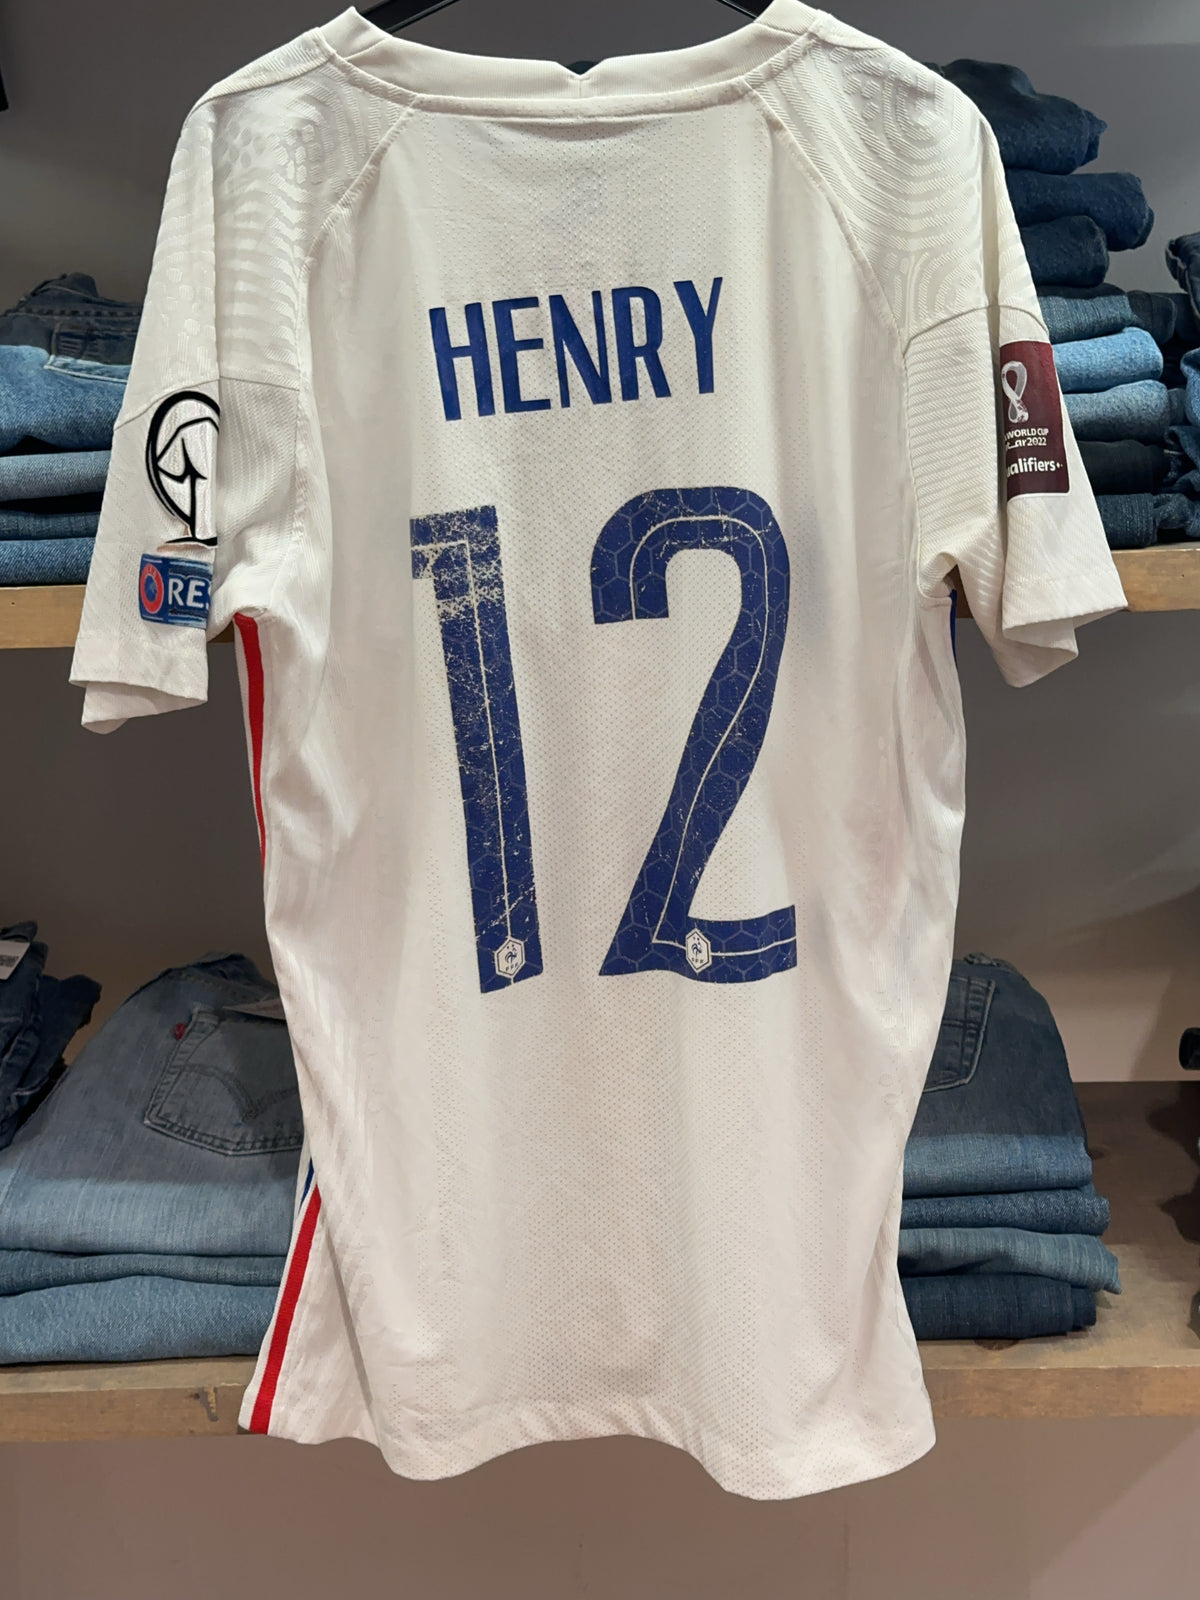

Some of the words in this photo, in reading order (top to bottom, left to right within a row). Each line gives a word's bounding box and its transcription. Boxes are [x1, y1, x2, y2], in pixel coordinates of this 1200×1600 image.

[428, 277, 723, 421] HENRY
[1007, 457, 1056, 477] alifiers
[168, 578, 211, 611] RE
[409, 486, 797, 993] 12
